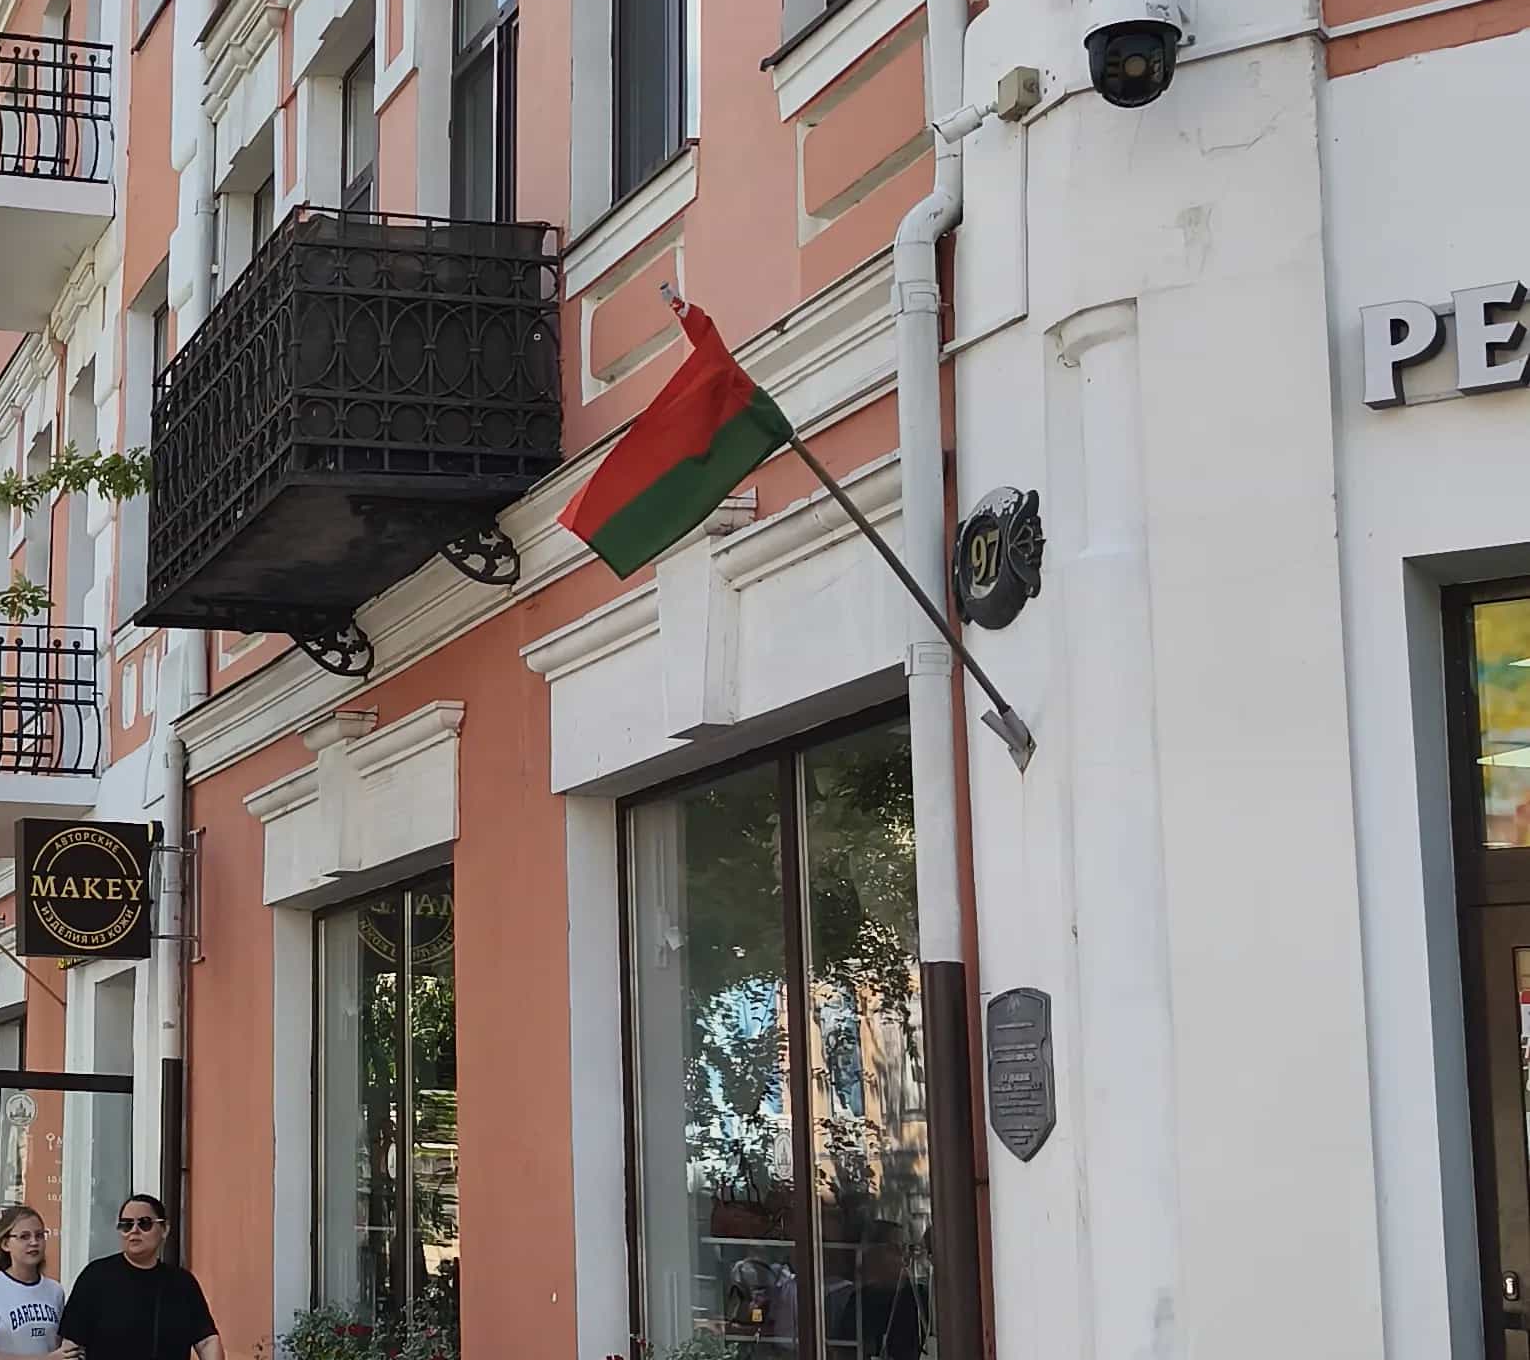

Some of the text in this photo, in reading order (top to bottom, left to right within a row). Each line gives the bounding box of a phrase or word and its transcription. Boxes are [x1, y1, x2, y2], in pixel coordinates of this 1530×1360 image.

[972, 529, 999, 583] 97
[54, 832, 121, 854] АВТОРСКИЕ
[30, 875, 144, 901] MAKEY
[41, 906, 135, 944] ИЗДЕЛИЯ ИЗ КОЖИ
